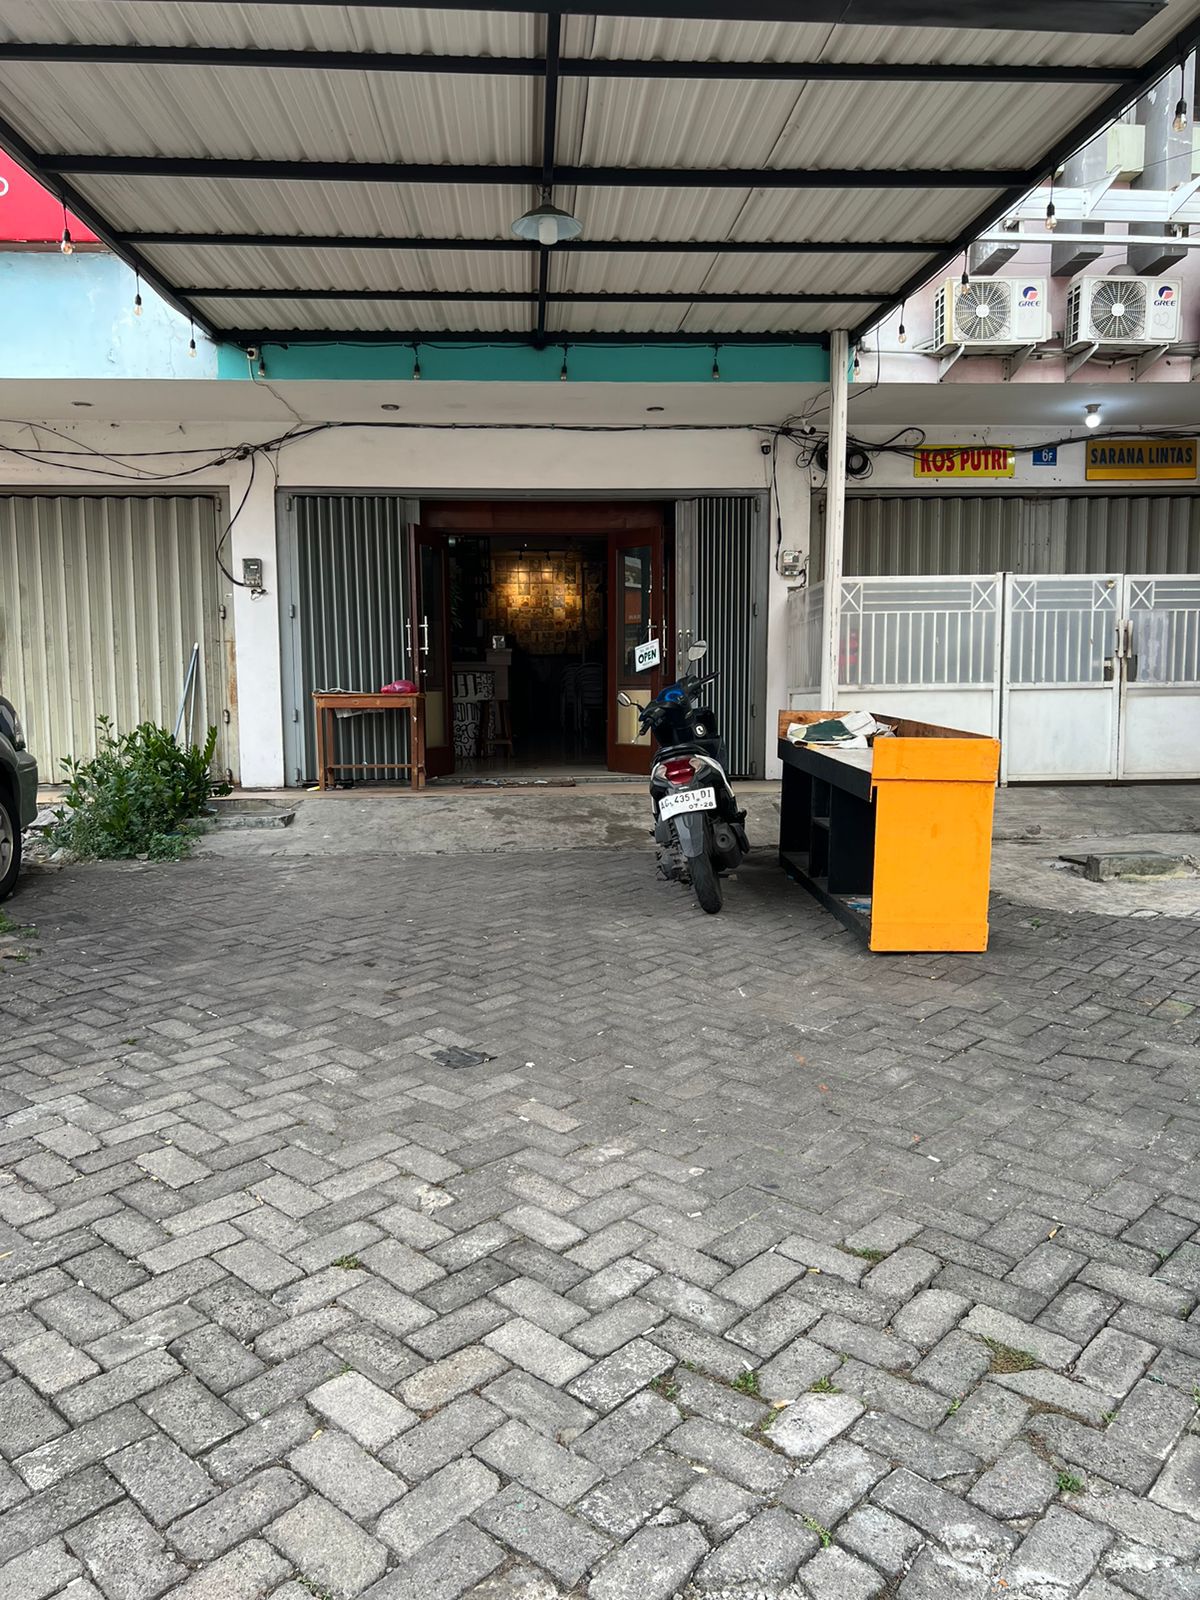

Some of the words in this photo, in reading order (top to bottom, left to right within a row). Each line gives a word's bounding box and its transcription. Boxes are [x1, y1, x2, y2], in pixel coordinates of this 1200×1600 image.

[920, 449, 955, 472] KOS
[960, 448, 1008, 471] PUTRI
[1091, 447, 1144, 464] SARANA
[1148, 447, 1193, 464] LINTAS
[638, 649, 657, 664] OPEN
[674, 792, 695, 803] 4351
